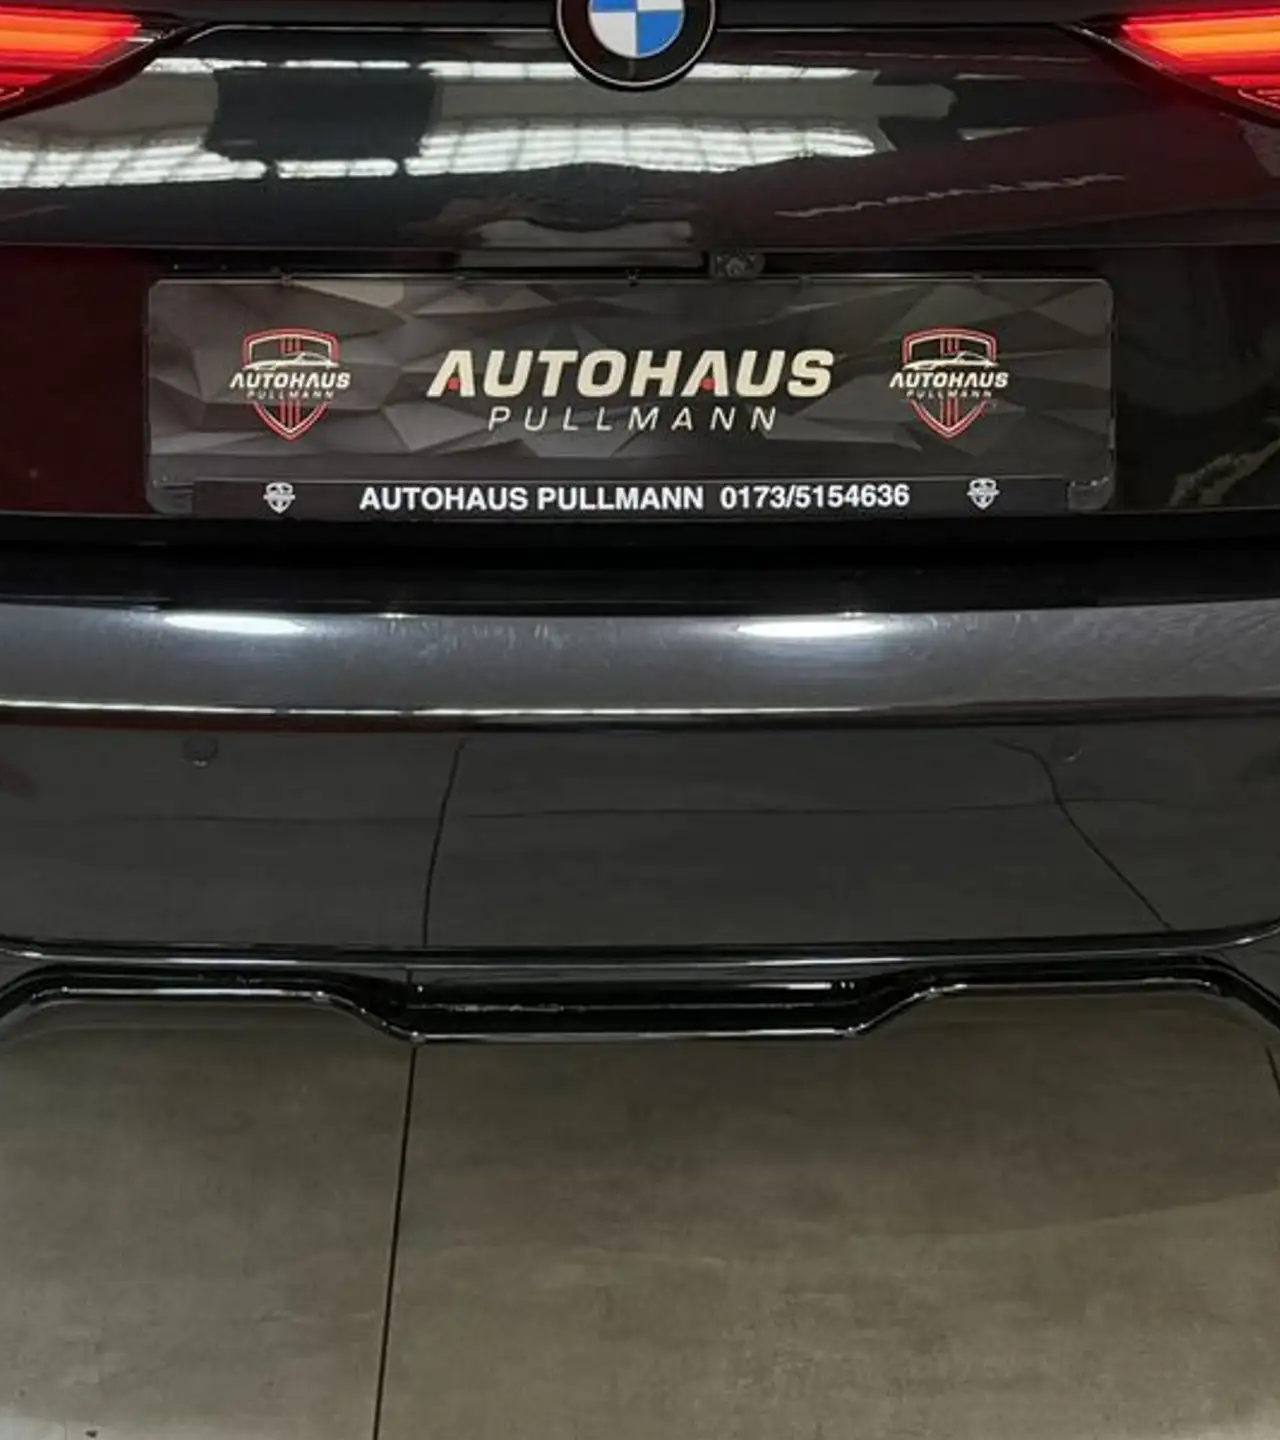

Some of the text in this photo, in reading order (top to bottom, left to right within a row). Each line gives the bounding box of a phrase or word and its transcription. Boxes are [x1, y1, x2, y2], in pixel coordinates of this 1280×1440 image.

[229, 371, 352, 389] AUTOHAUS
[426, 349, 835, 398] AUTOHAUS
[888, 371, 1010, 389] AUTOHAUS
[487, 406, 777, 432] PULLMANN
[359, 484, 911, 511] AUTOHAUS PULLMANN 0173/5154636
